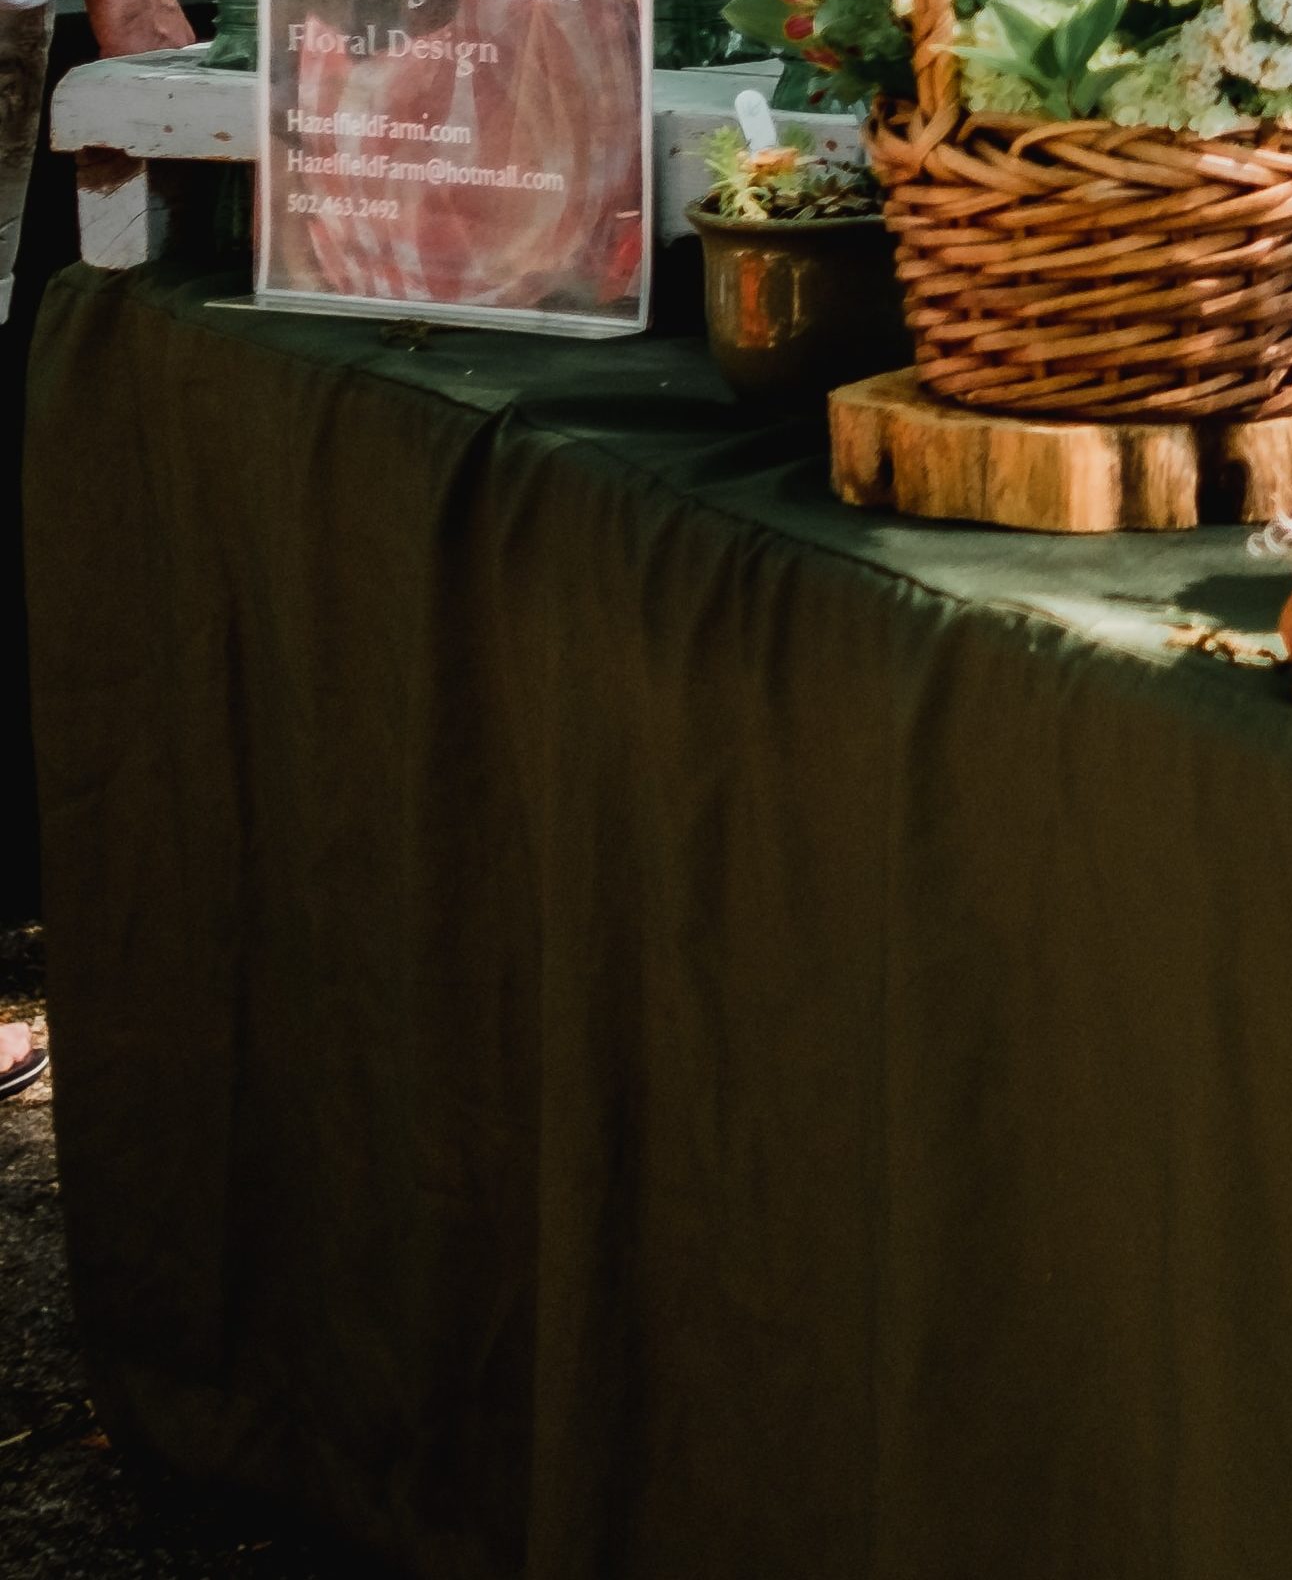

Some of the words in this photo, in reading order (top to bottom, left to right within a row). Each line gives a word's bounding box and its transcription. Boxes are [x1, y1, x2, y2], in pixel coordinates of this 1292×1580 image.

[286, 23, 376, 57] Floral
[386, 29, 500, 77] Design
[286, 109, 472, 145] HazelfieldFarm.com
[286, 149, 565, 192] HazelfieldFarm@hotmail.com
